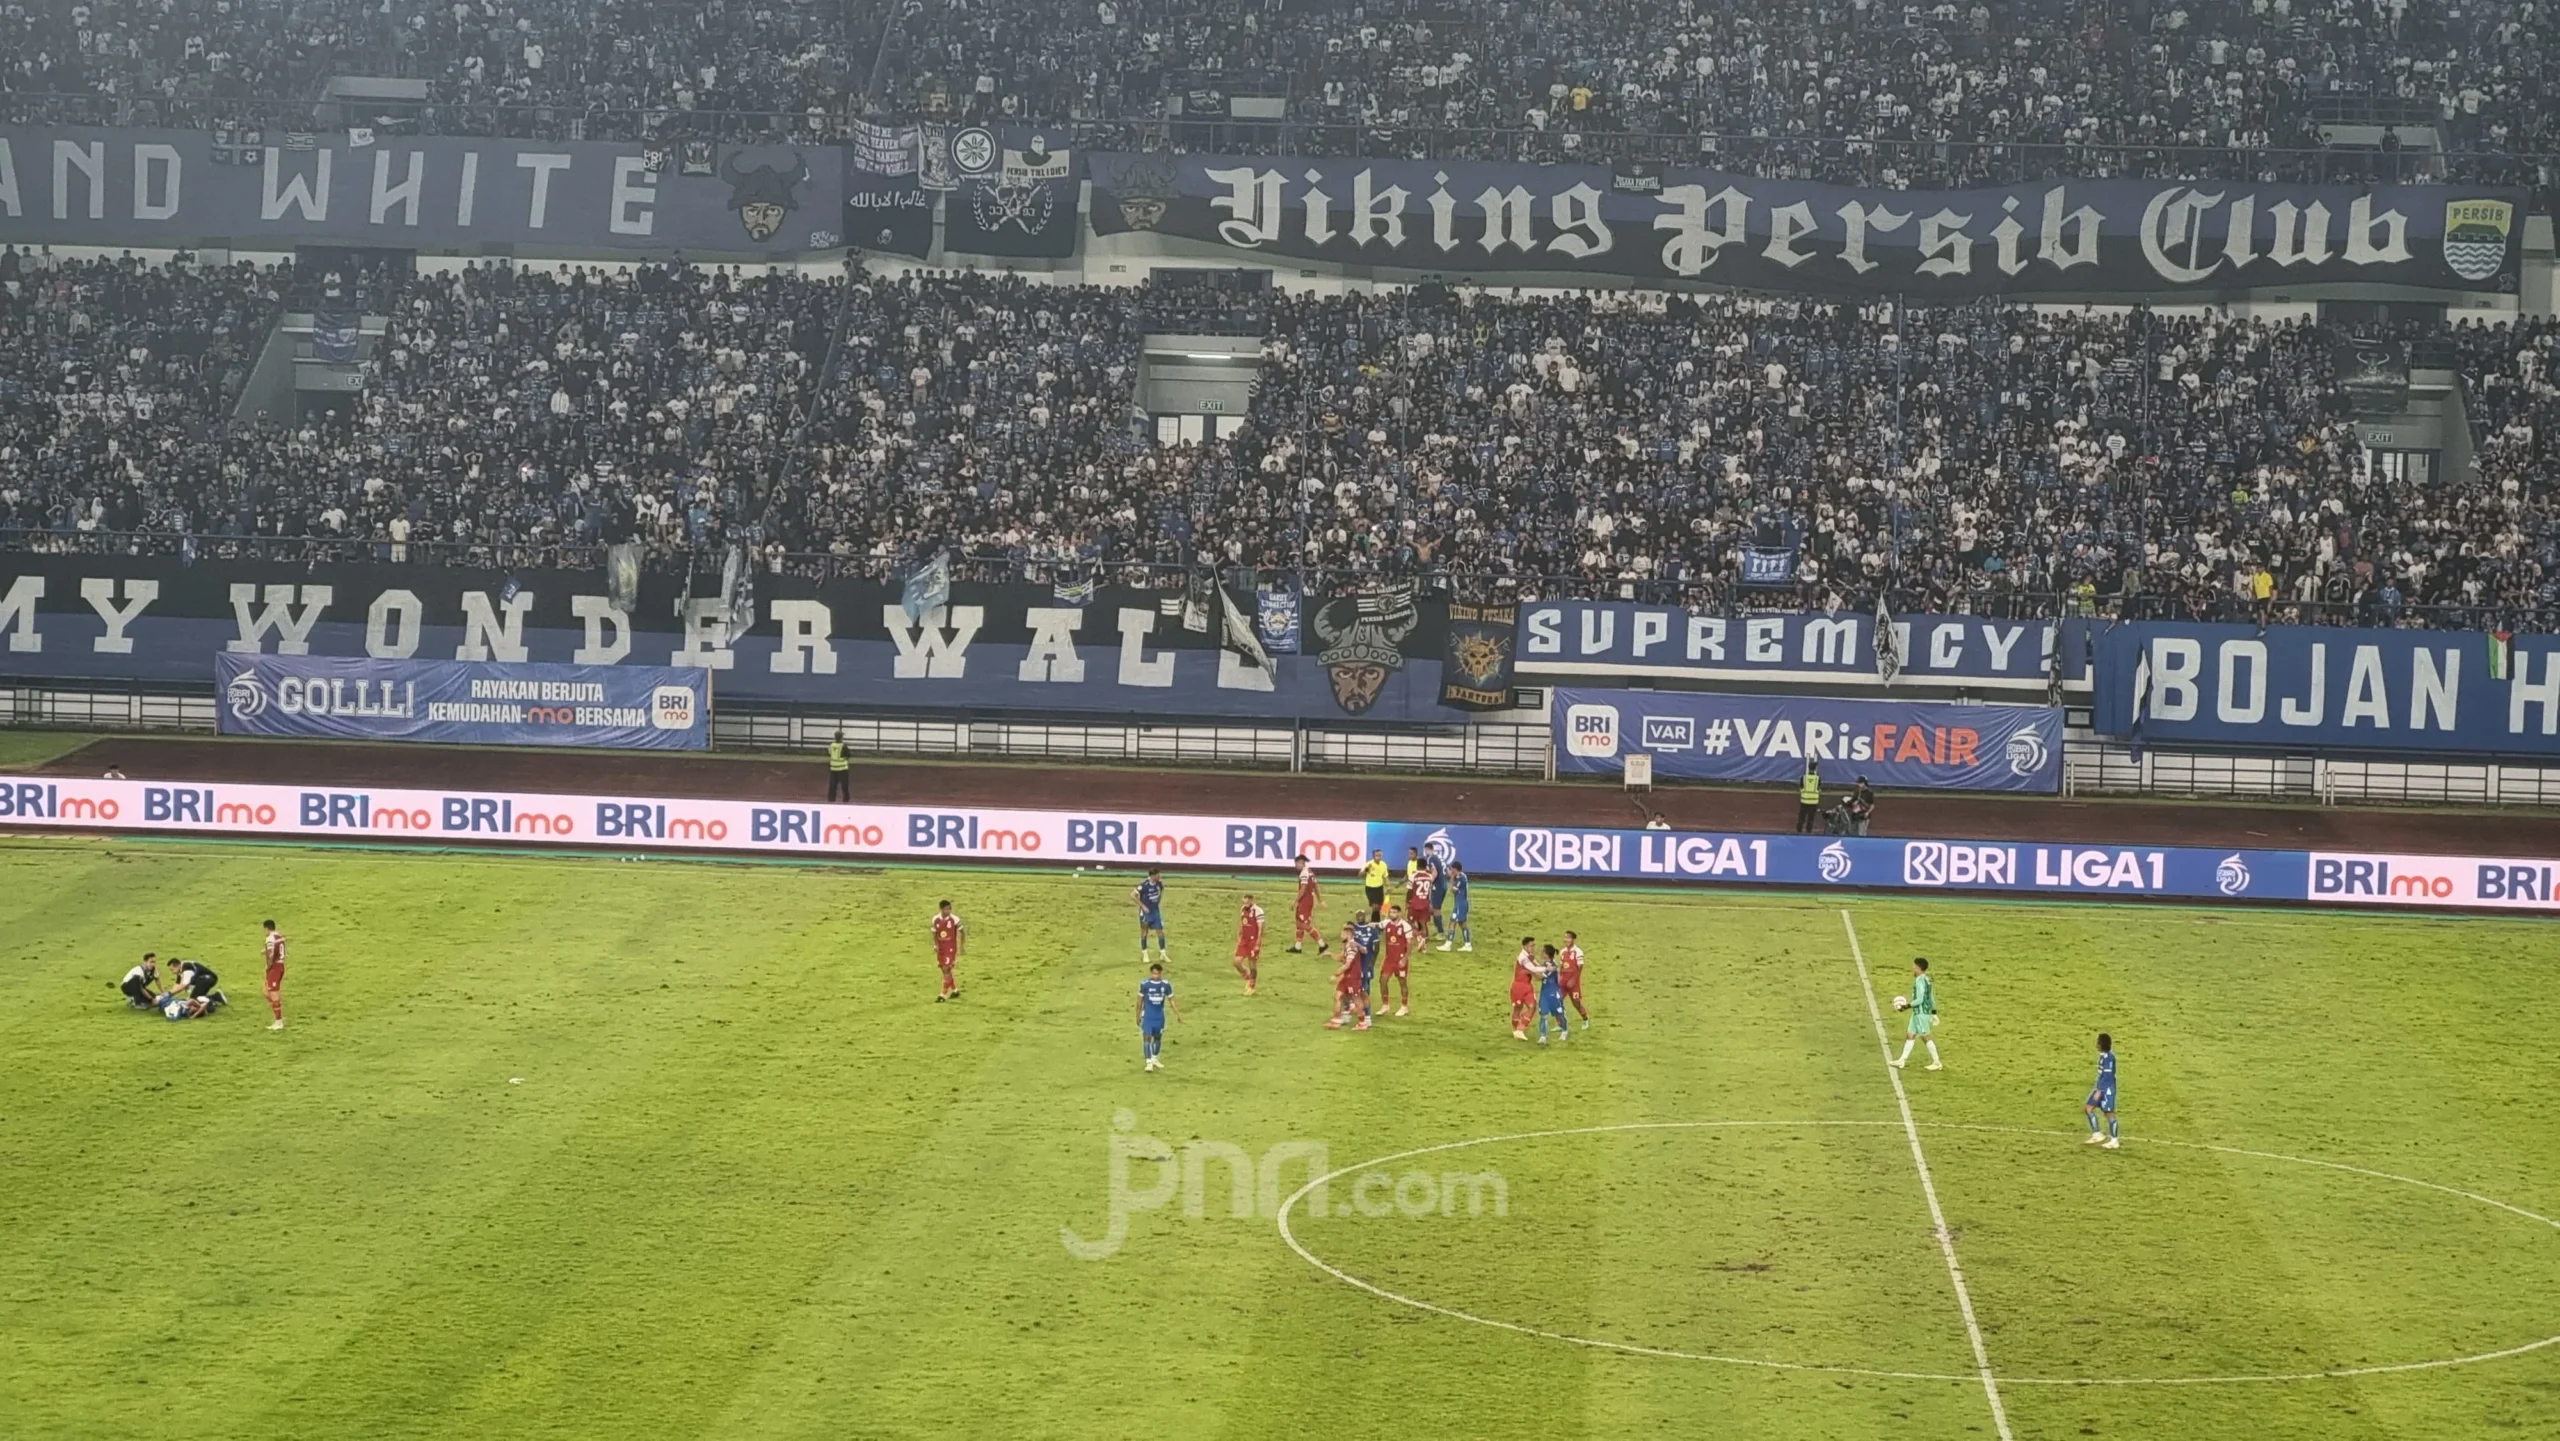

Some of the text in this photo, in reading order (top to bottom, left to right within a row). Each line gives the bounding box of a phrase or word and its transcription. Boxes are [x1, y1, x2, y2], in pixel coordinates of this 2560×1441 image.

[261, 148, 657, 235] WHITE
[1204, 167, 2414, 283] Viking Persib Club
[2453, 207, 2504, 221] PERSIB
[1199, 401, 1222, 411] EXIT
[2367, 432, 2391, 442] EXIT
[1449, 603, 1515, 626] VIKING PUSAKA
[1527, 608, 2056, 673] SUPREMCY!
[278, 676, 415, 719] GOLLL!
[471, 679, 604, 702] RAYAKAN BERJUTA
[659, 695, 689, 710] BRI
[2149, 637, 2461, 731] BOJAN
[575, 707, 647, 727] BERSAMA
[664, 710, 688, 721] mo
[1575, 715, 1611, 734] BRI
[1649, 724, 1687, 740] VAR
[1581, 734, 1611, 747] mo
[1703, 718, 1980, 767] #VARisFAIR
[144, 787, 276, 826] BRImo
[300, 792, 432, 830] BRImo
[442, 797, 573, 835] BRImo
[596, 802, 728, 841] BRImo
[751, 808, 883, 846] BRImo
[908, 813, 1041, 852] BRImo
[1067, 819, 1200, 857] BRImo
[1226, 824, 1360, 862] BRImo
[1554, 833, 1620, 872] BRI
[1949, 846, 2016, 884] BRI
[1415, 880, 1430, 896] 29
[2314, 859, 2453, 898] BRImo
[2477, 864, 2560, 901] BRI
